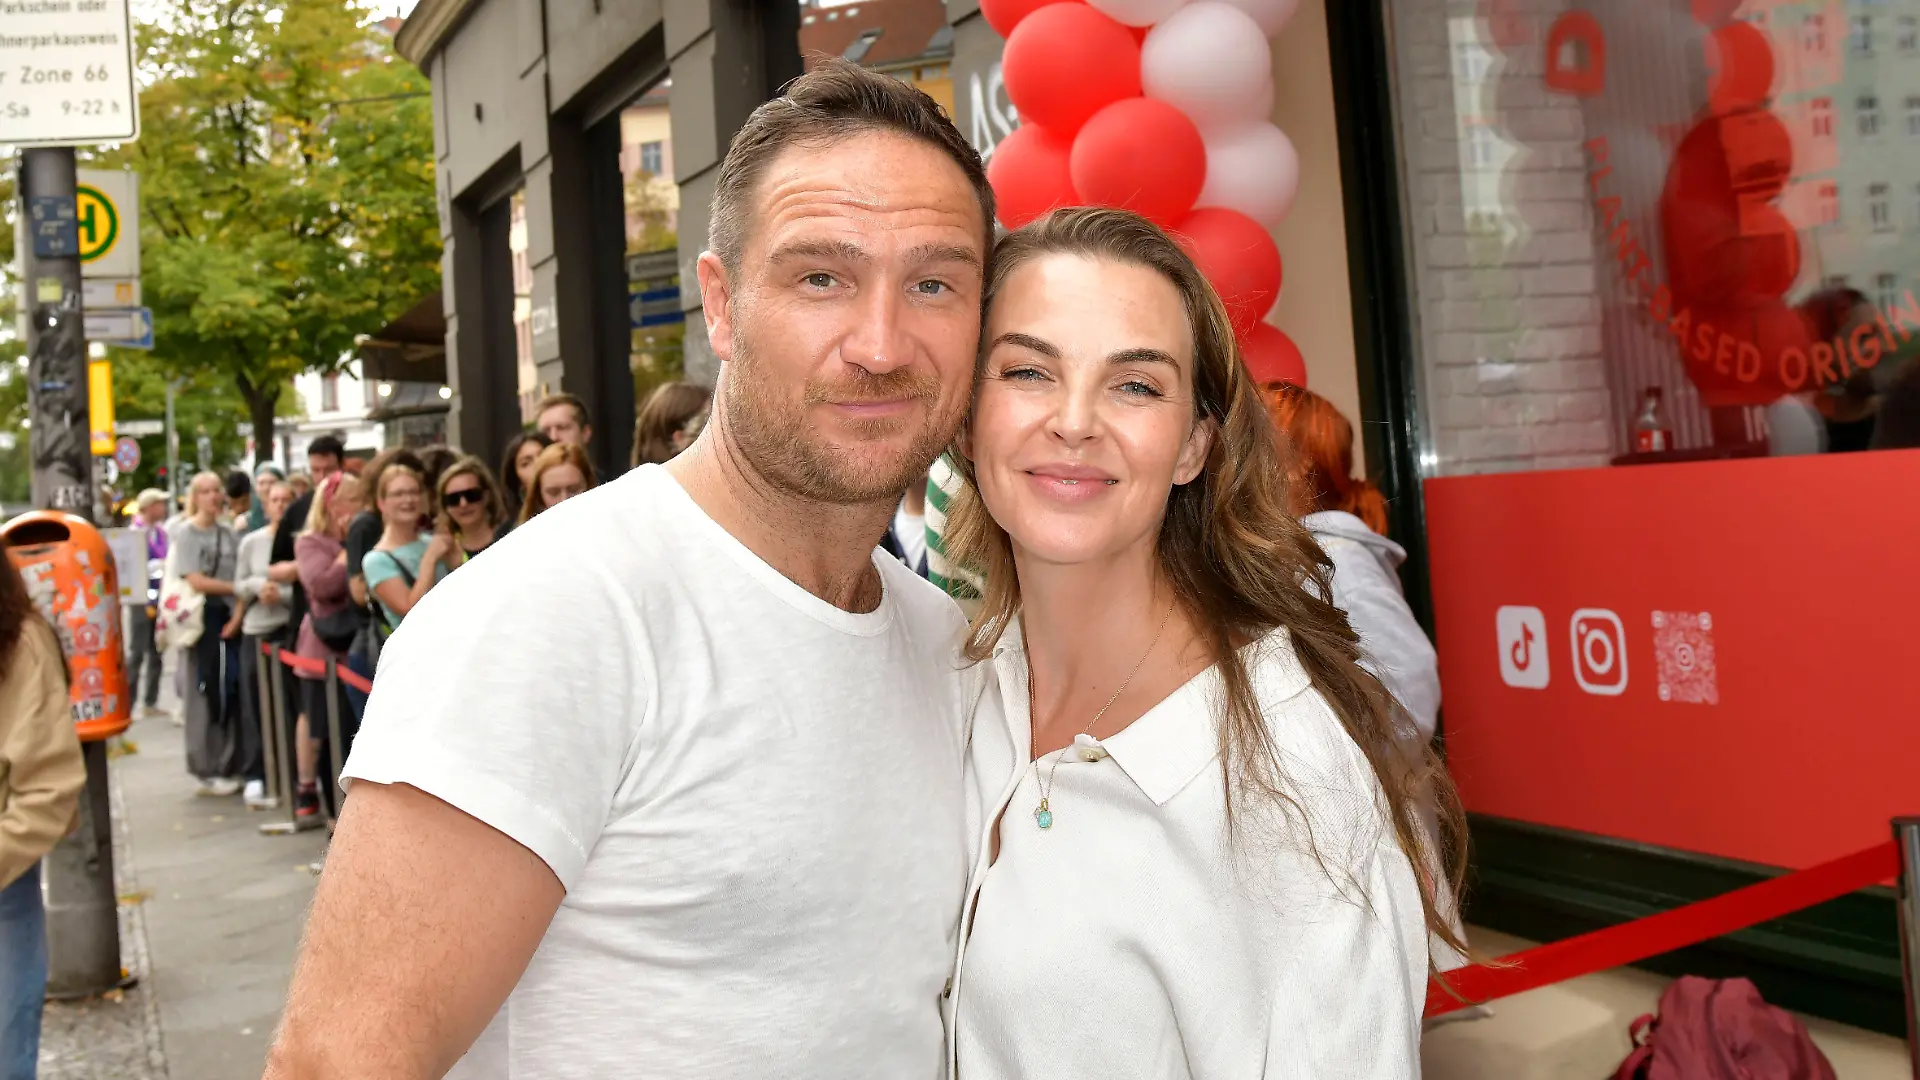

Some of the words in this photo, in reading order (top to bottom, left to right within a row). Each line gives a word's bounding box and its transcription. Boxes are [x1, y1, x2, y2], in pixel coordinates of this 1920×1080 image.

[77, 0, 107, 12] oder
[20, 65, 73, 85] Zone
[84, 64, 109, 82] 66
[61, 99, 104, 116] 9-22
[1585, 135, 1762, 383] PLANT-BASED
